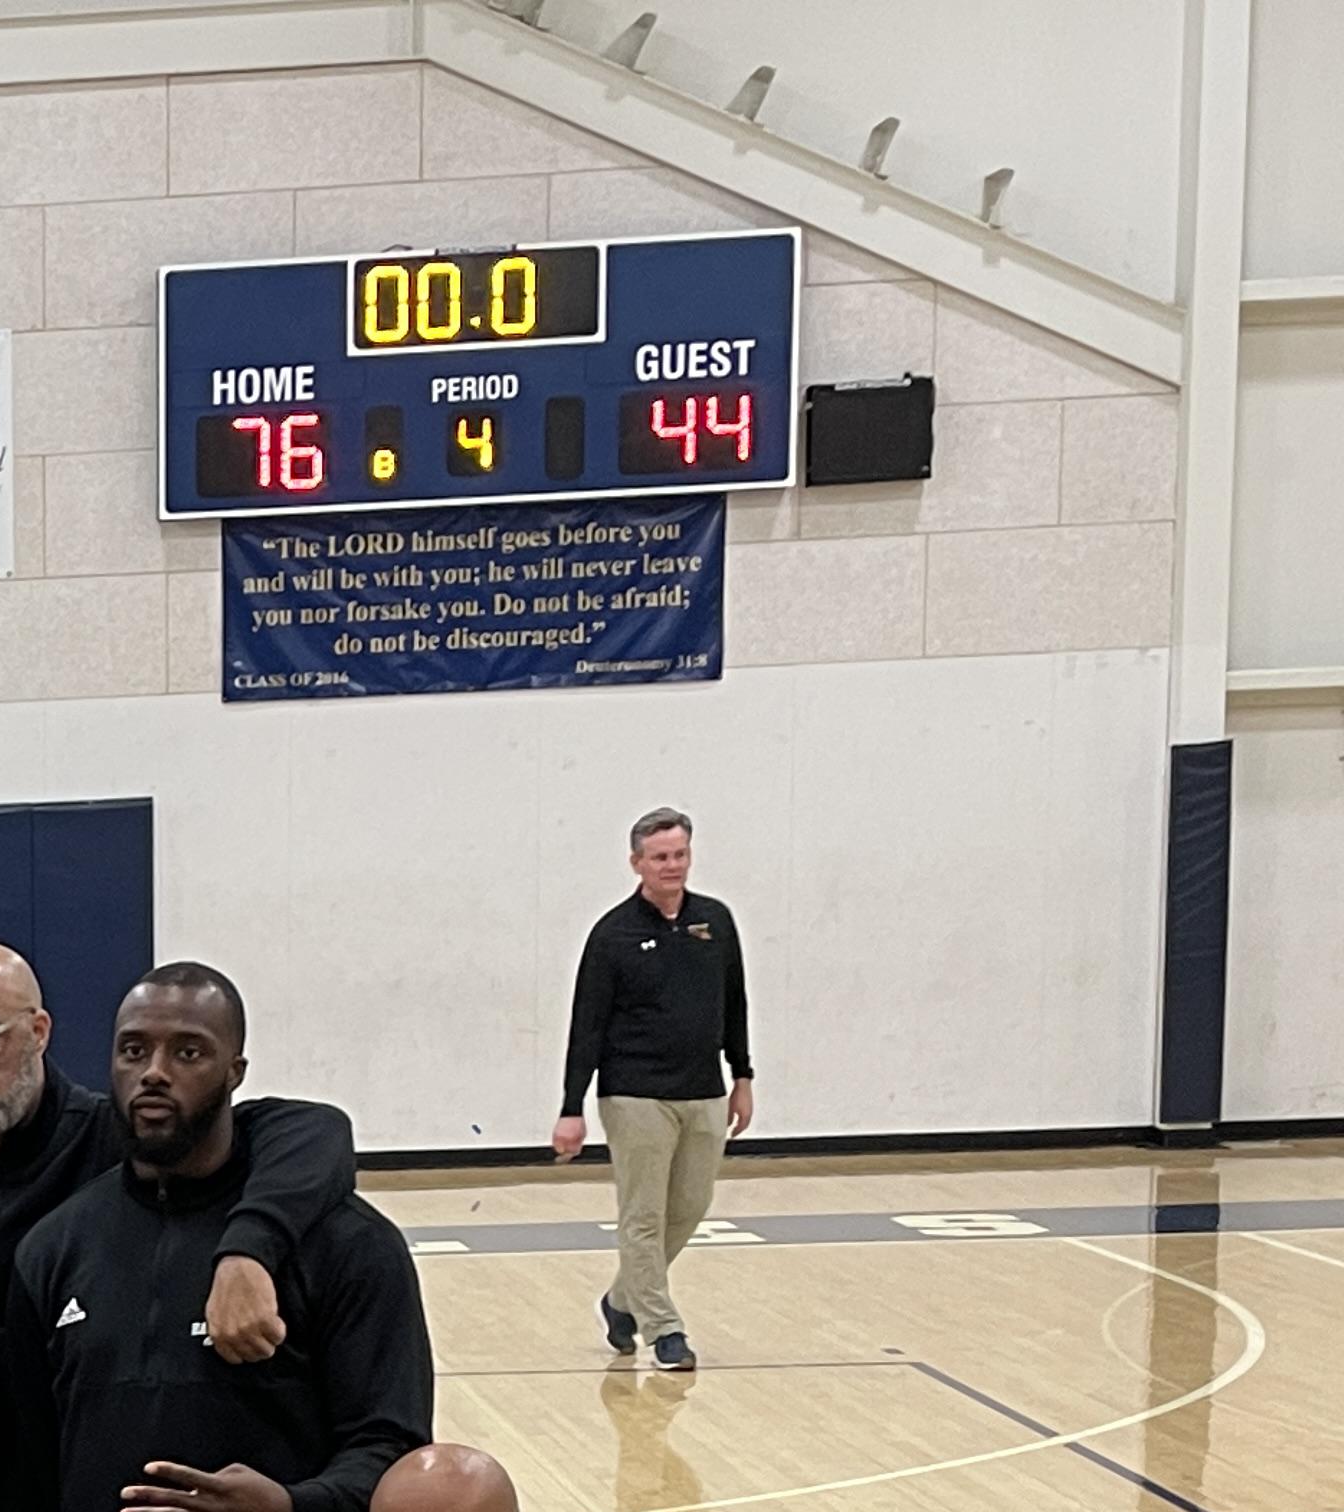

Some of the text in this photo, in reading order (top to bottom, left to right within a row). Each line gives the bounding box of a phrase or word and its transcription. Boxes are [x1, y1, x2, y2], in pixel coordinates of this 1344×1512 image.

[365, 257, 536, 342] 00.0
[636, 340, 755, 382] GUEST
[212, 366, 314, 405] HOME
[432, 375, 518, 403] PERIOD
[457, 418, 493, 471] 4
[652, 395, 750, 464] 44
[232, 414, 323, 490] 76
[327, 532, 404, 557] LORD
[411, 527, 499, 552] himself
[501, 529, 552, 554] goes
[558, 521, 633, 546] before
[638, 522, 681, 547] you
[243, 553, 703, 594] and will be with you; he will never leave
[251, 584, 690, 632] you nor forsake you. Do not be afraid;
[334, 633, 363, 655] do
[369, 633, 406, 653] not
[413, 630, 441, 651] be
[233, 673, 286, 688] CLASS
[290, 672, 312, 686] OF
